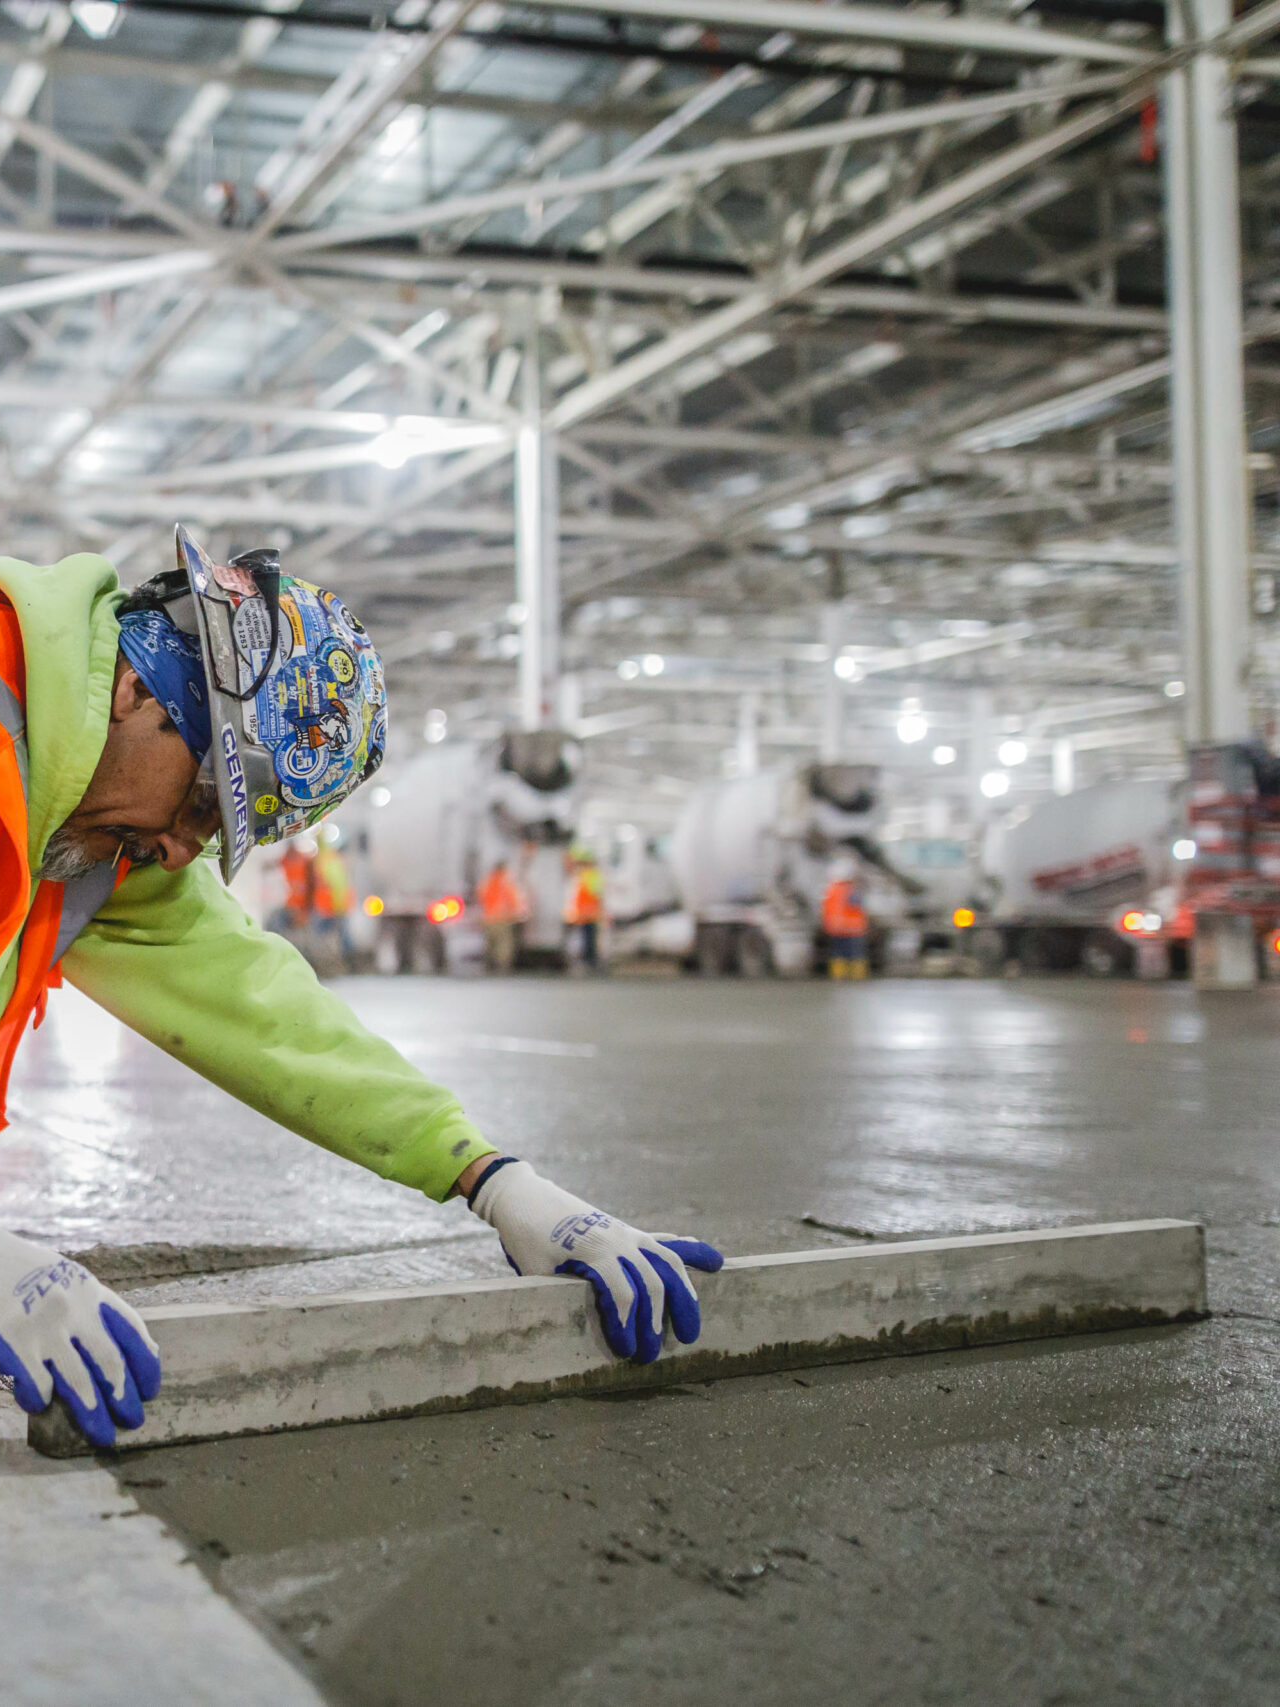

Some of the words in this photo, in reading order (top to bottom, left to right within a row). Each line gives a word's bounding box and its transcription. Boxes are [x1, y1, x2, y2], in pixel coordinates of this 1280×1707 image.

[238, 630, 248, 649] 1253
[249, 713, 258, 734] 1952
[222, 727, 248, 869] CEMENT
[562, 1211, 604, 1251] FLEX
[22, 1260, 70, 1315] FLEX
